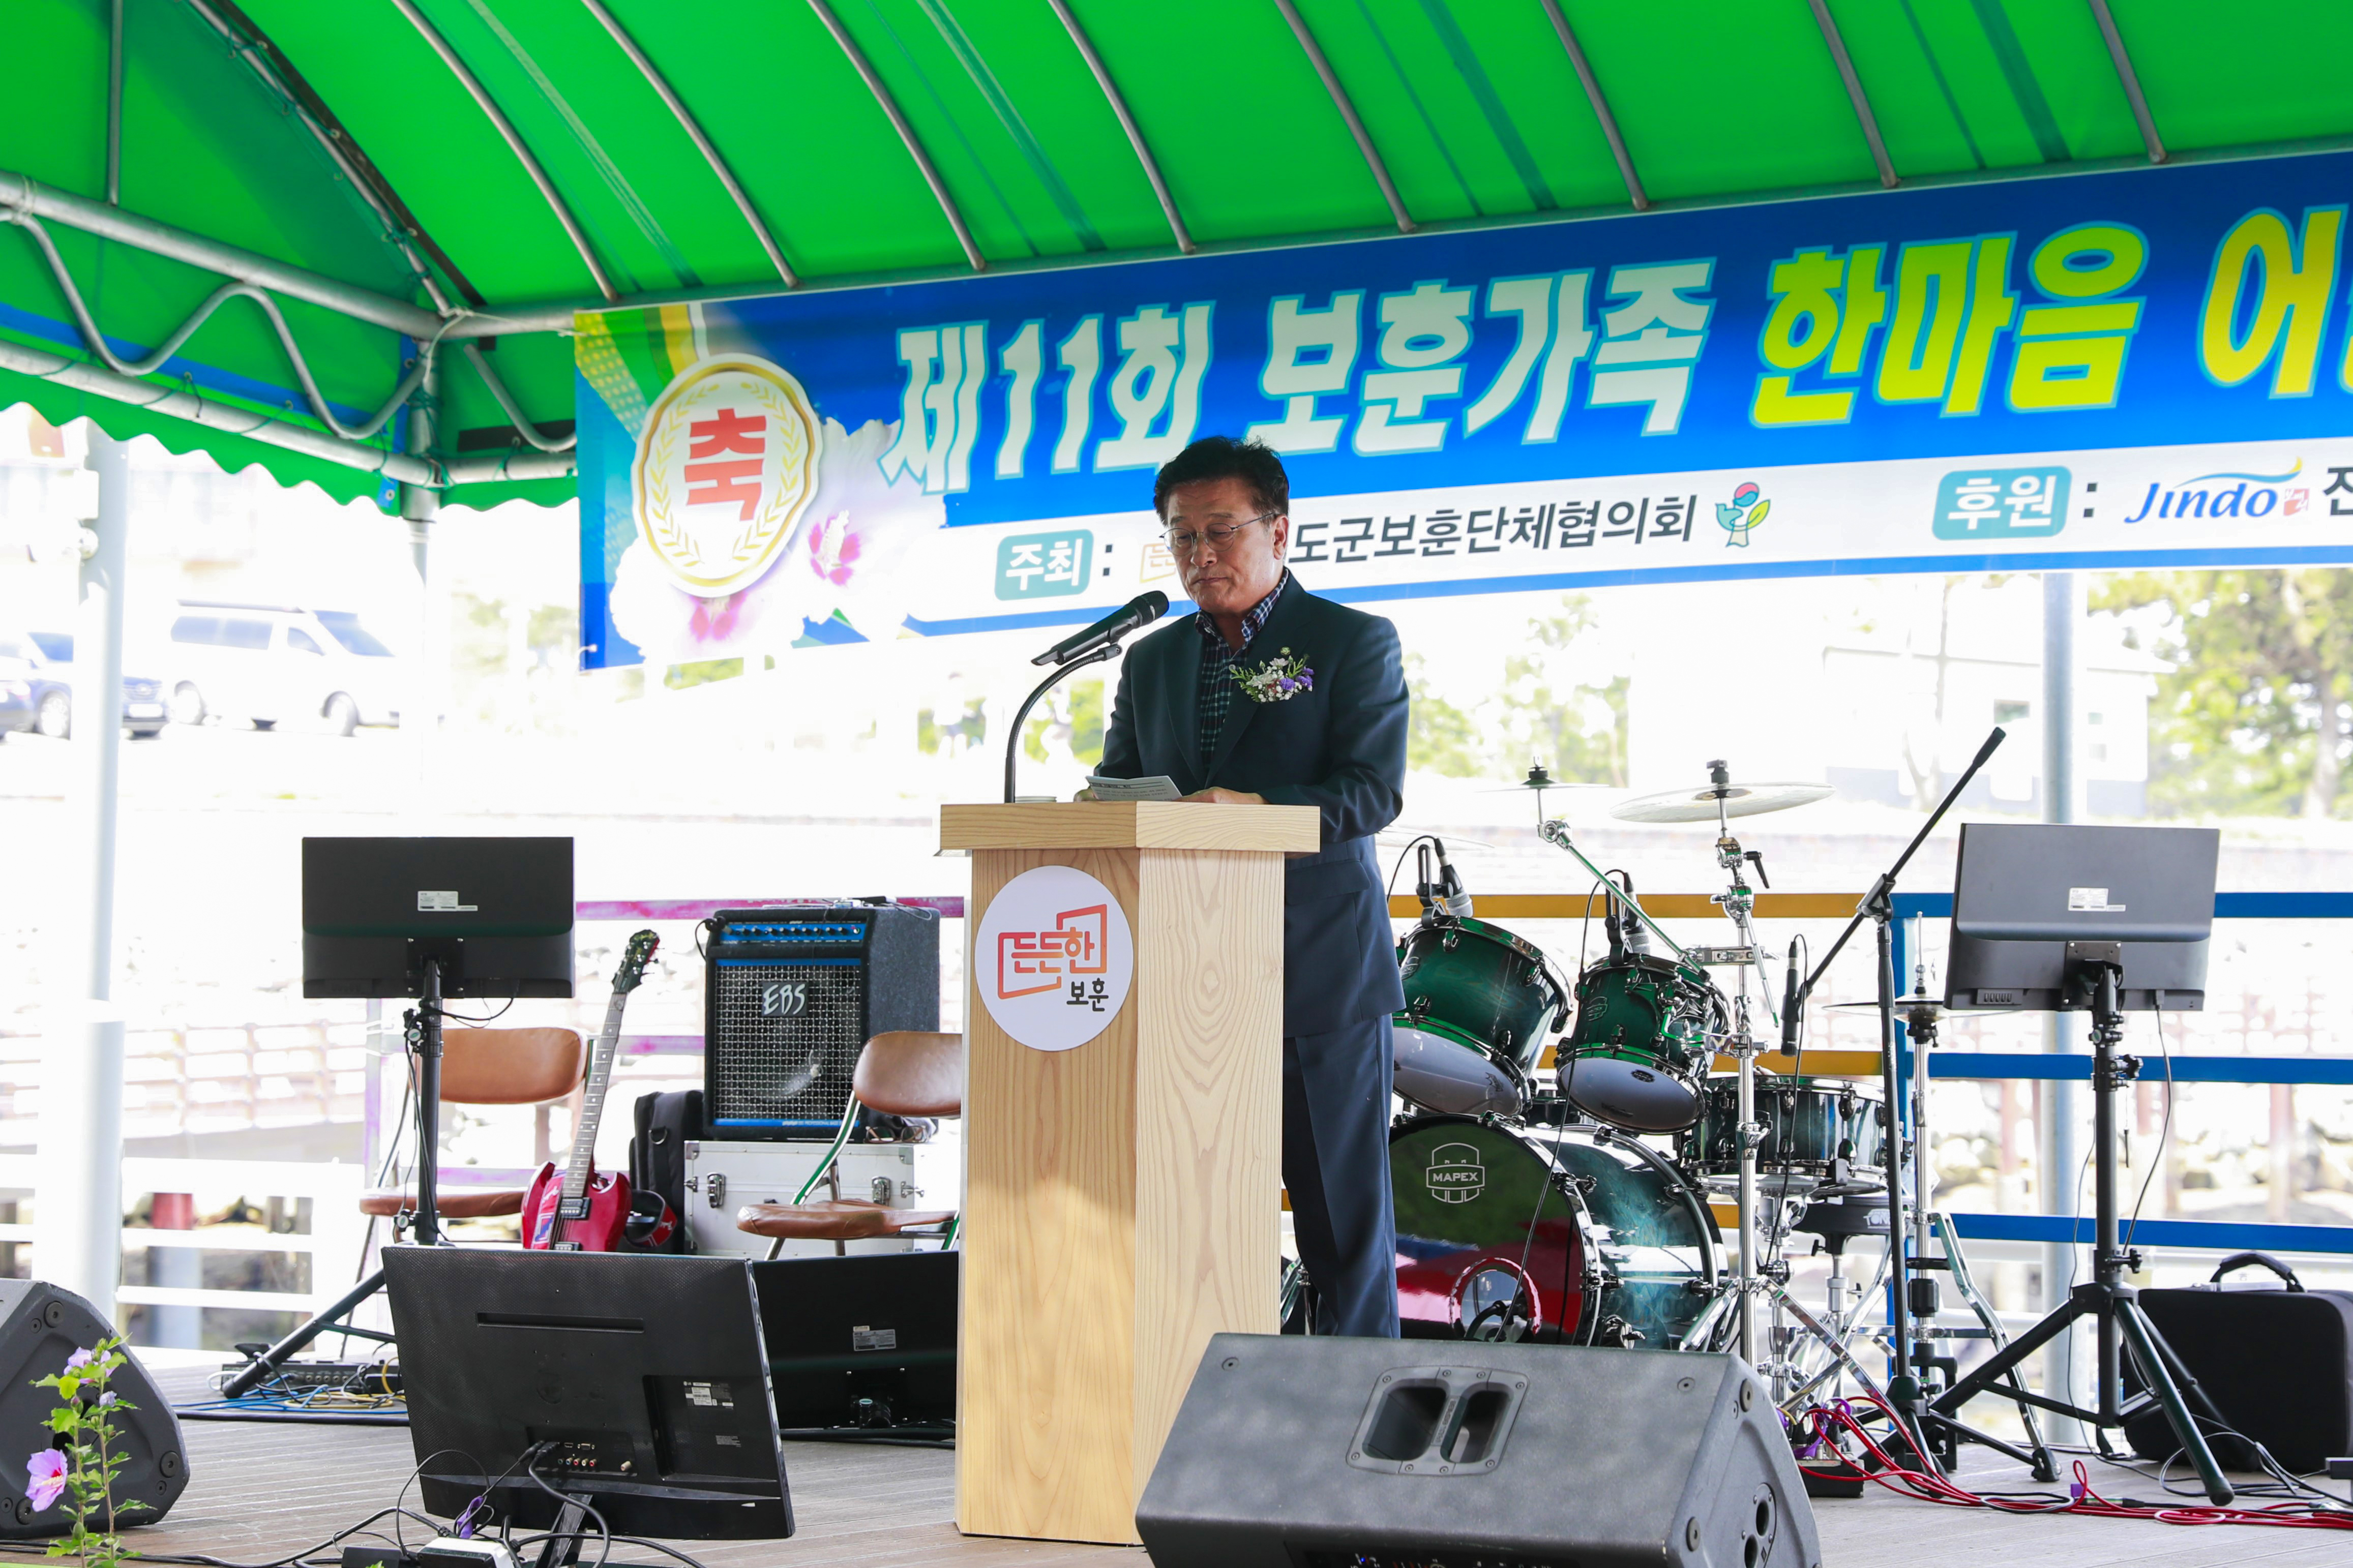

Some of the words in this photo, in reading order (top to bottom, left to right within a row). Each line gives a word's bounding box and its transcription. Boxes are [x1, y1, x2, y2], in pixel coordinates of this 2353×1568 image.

[878, 300, 1216, 494] 제11회
[1243, 257, 1717, 456] 보훈가족
[1749, 220, 2149, 429] 한마음
[2197, 204, 2353, 400] 어
[684, 408, 766, 521] 축
[1947, 472, 2057, 531] 후원
[1004, 536, 1084, 591] 주최
[1288, 495, 1697, 565] 도군보훈단체협의회
[763, 983, 806, 1015] EBS
[1066, 978, 1109, 1012] 보훈
[1433, 1172, 1478, 1182] MAPEX
